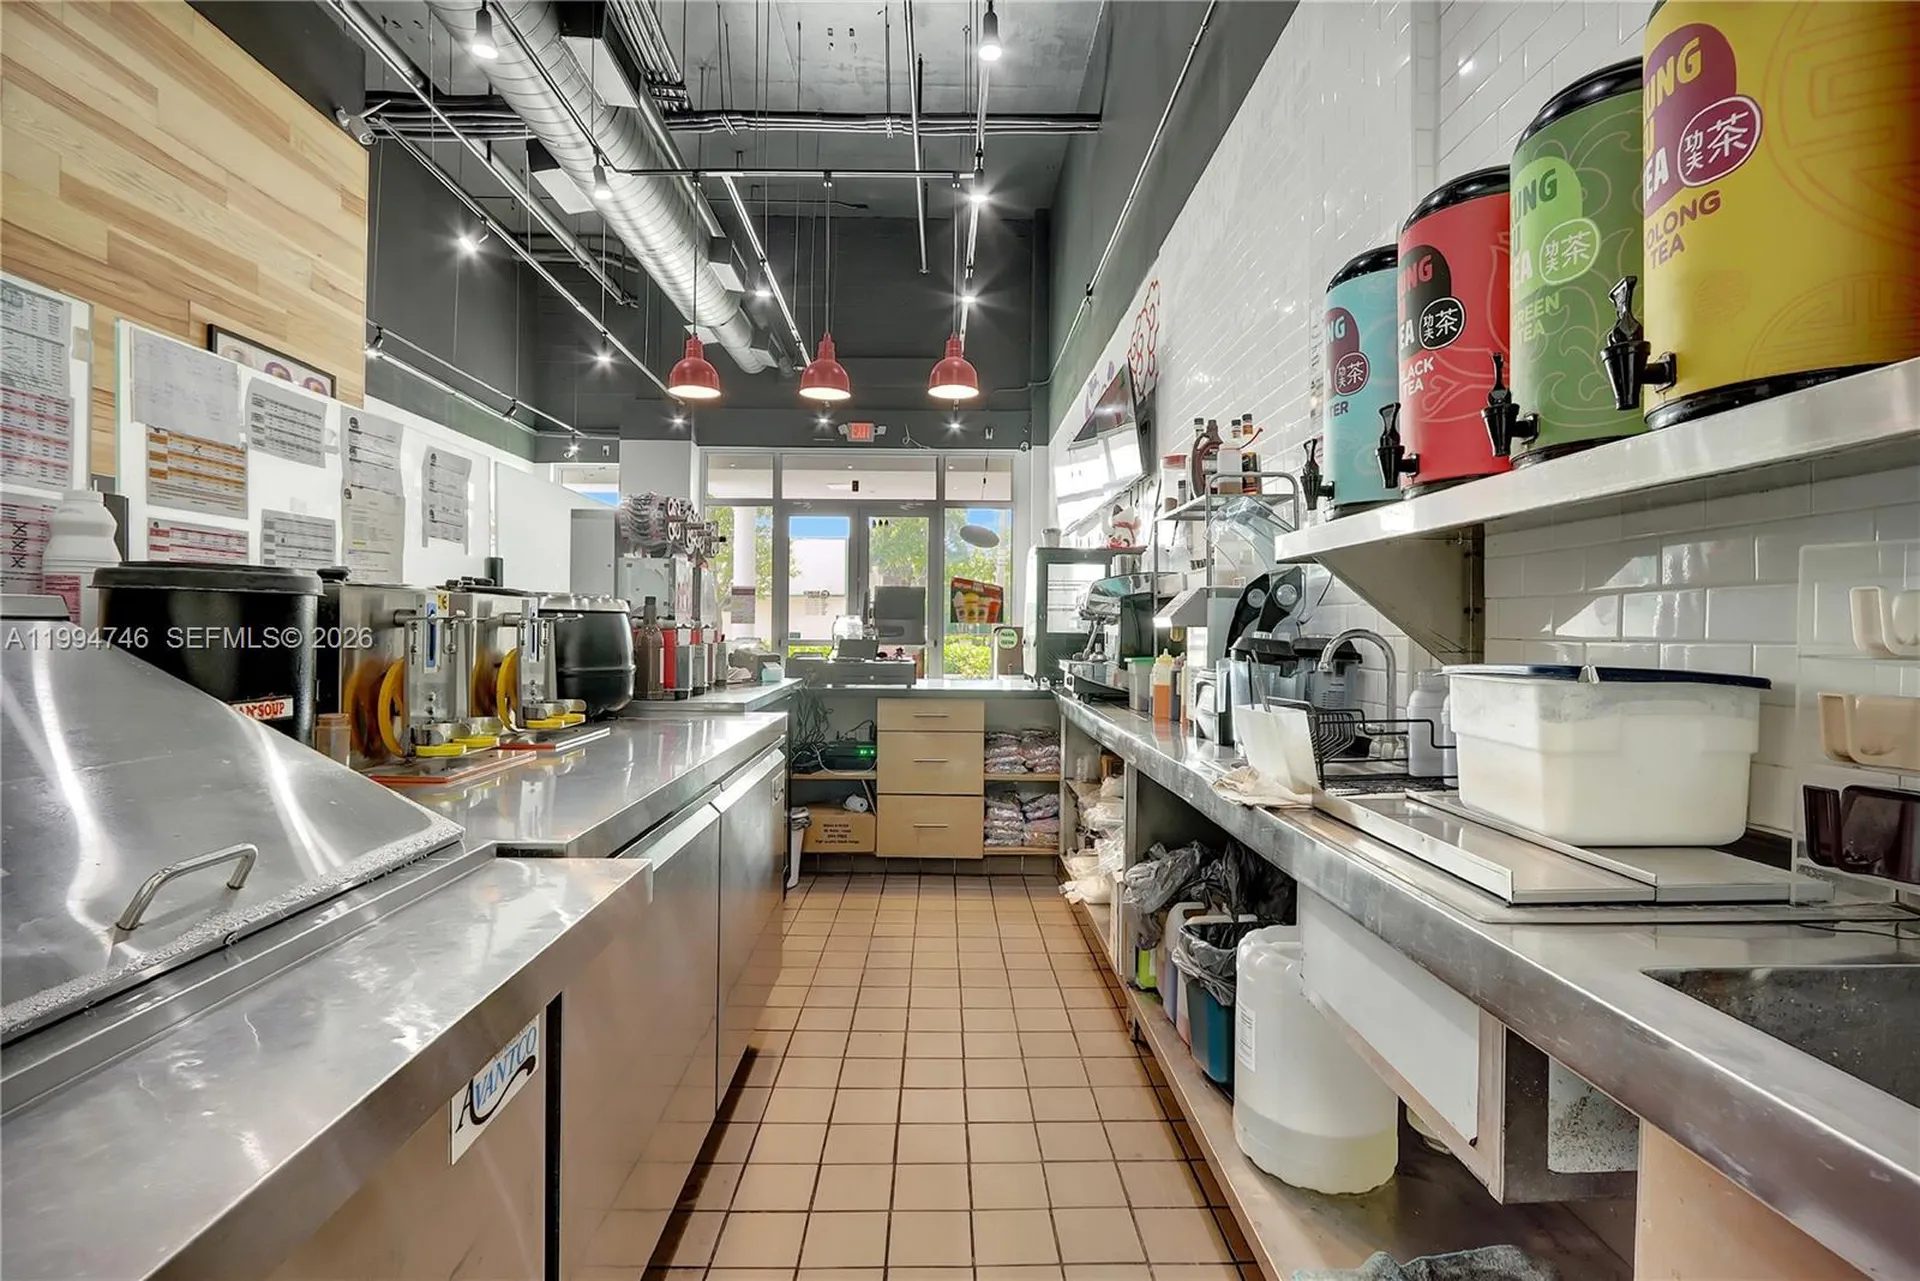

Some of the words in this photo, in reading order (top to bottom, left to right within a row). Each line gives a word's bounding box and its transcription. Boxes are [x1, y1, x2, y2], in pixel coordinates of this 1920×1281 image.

[1645, 37, 1701, 118] UNG
[1513, 168, 1557, 224] UNG
[1644, 147, 1669, 201] EA
[1646, 190, 1721, 249] OLONG
[1513, 251, 1533, 288] EA
[1650, 233, 1685, 270] TEA
[1399, 319, 1415, 350] EA
[1517, 319, 1545, 346] TEA
[1329, 401, 1349, 419] TER
[455, 1026, 538, 1133] AVANTCO
